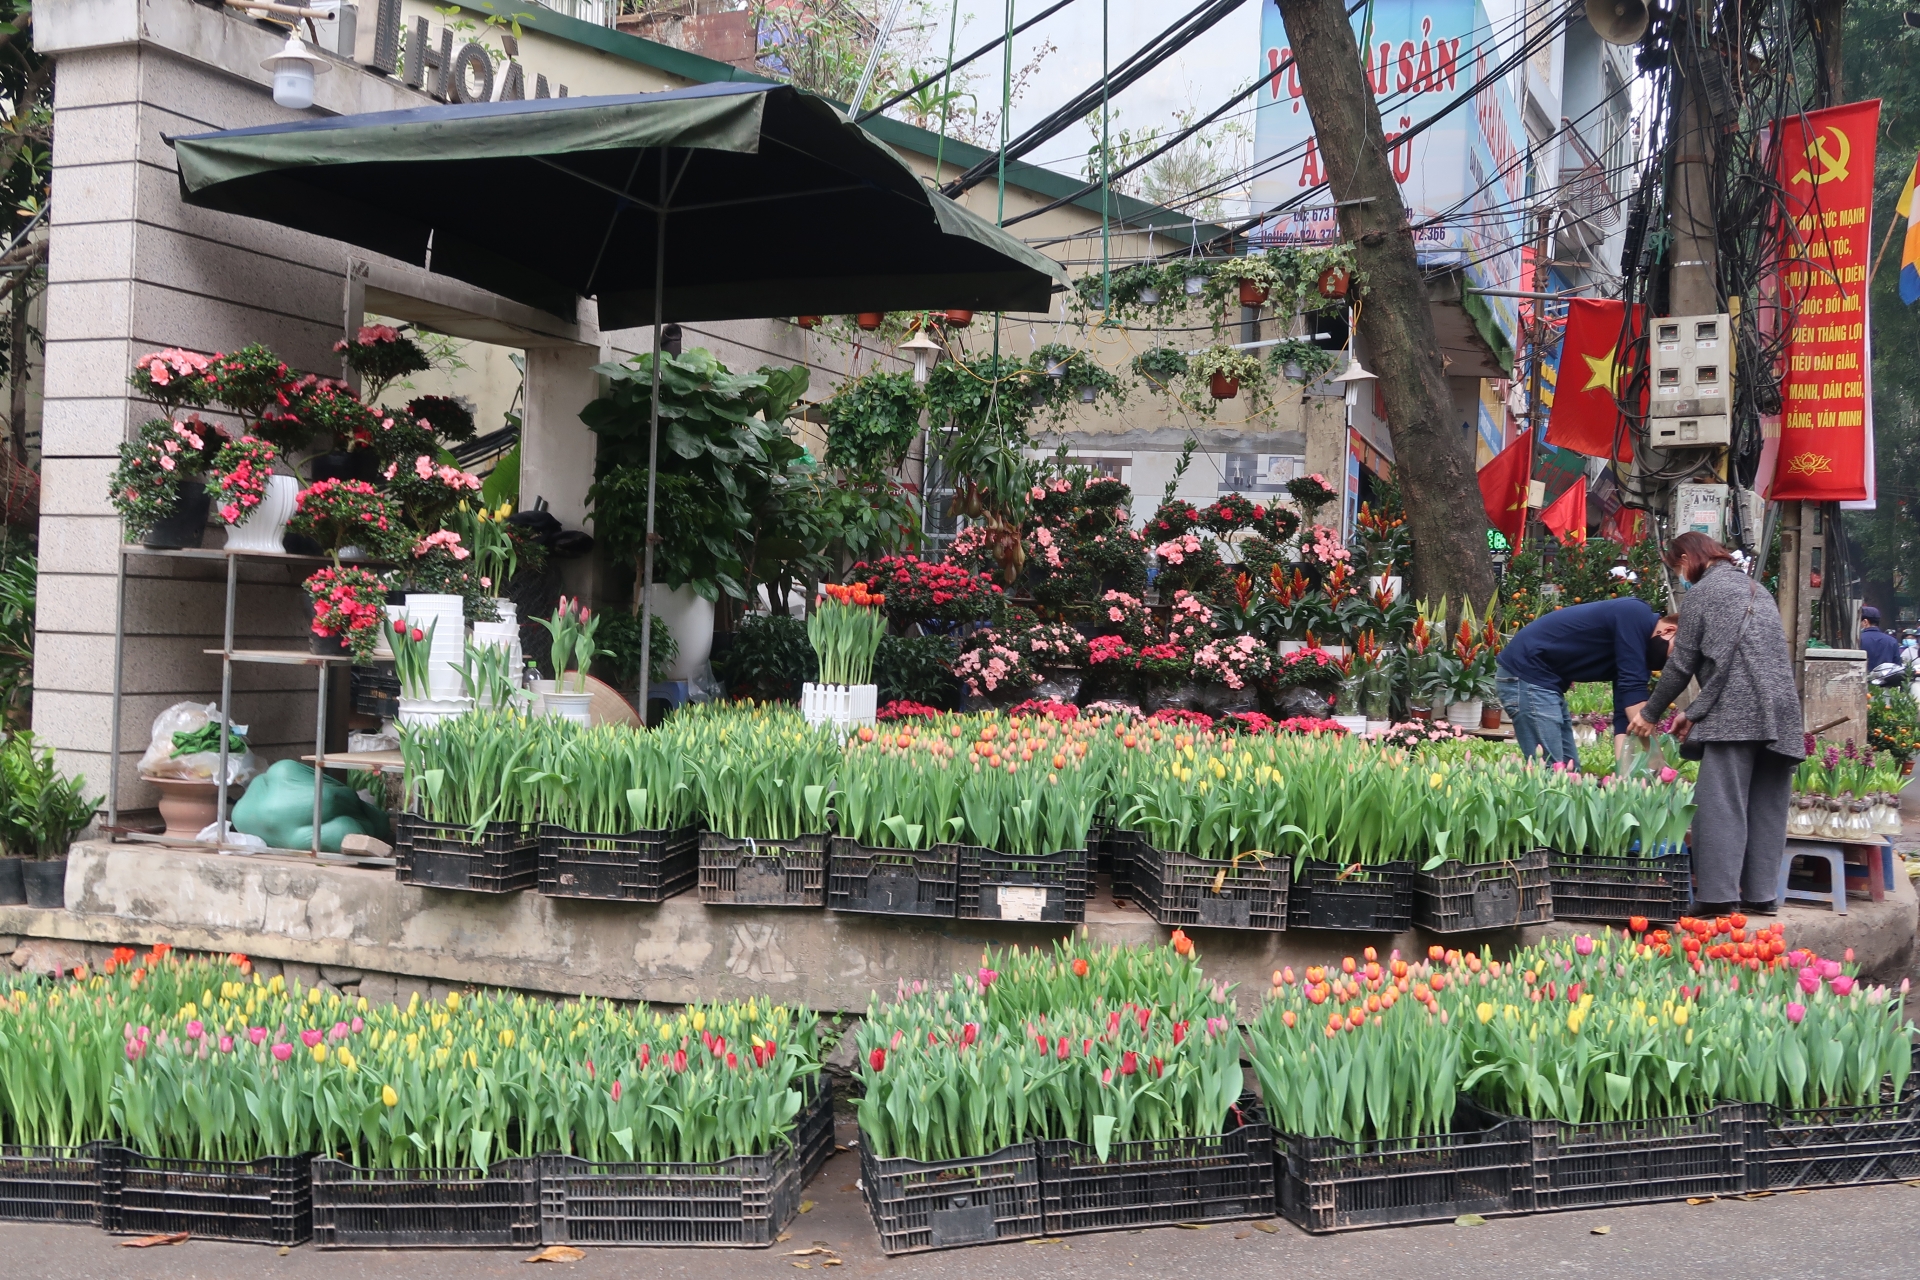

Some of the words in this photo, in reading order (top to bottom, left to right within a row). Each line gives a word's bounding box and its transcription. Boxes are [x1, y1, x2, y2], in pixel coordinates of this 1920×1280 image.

[403, 14, 570, 104] HOÀN
[1397, 17, 1459, 93] SẢN
[1312, 207, 1330, 222] 673
[1840, 207, 1865, 229] MẠNH
[1834, 236, 1853, 259] TỘC,
[1844, 262, 1865, 286] DIỆN
[1798, 296, 1823, 318] CUỘC
[1825, 290, 1841, 314] ĐỔI
[1842, 290, 1862, 313] MỚI,
[1791, 324, 1815, 346] HIỆN
[1817, 321, 1847, 343] THẮNG
[1848, 321, 1862, 343] LỢI
[1791, 352, 1812, 371] TIÊU
[1813, 351, 1834, 371] DÂN
[1835, 349, 1859, 371] GIÀU,
[1789, 383, 1820, 404] MẠNH,
[1822, 379, 1842, 400] DÂN
[1844, 374, 1865, 400] CHỦ,
[1786, 404, 1814, 429] BẰNG,
[1817, 408, 1836, 428] VĂN
[1838, 410, 1862, 427] MINH
